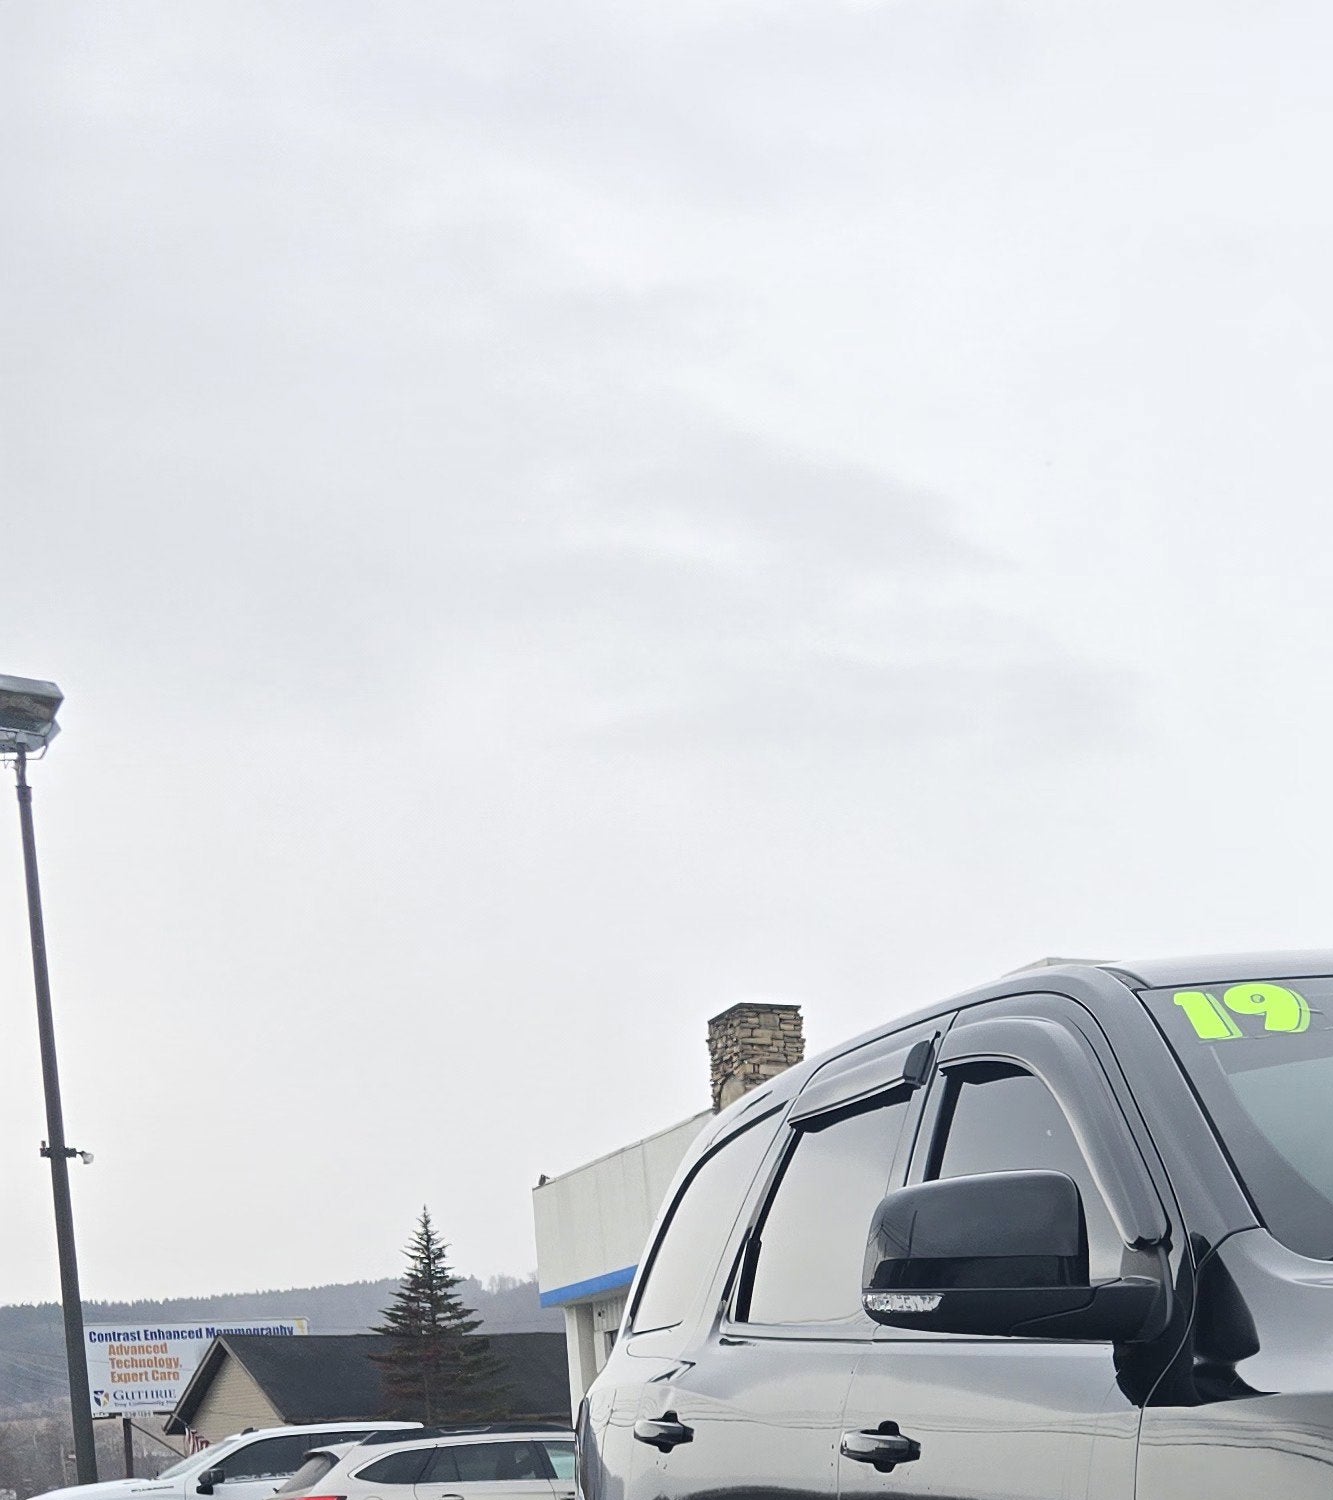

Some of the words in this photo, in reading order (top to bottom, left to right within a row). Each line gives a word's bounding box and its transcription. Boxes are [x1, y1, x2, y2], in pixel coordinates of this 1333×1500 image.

[1173, 983, 1311, 1041] 19
[89, 1330, 142, 1344] Contrast
[143, 1327, 203, 1341] Enhanced
[108, 1342, 168, 1356] Advanced
[110, 1370, 149, 1383] Expert
[151, 1370, 180, 1382] Care
